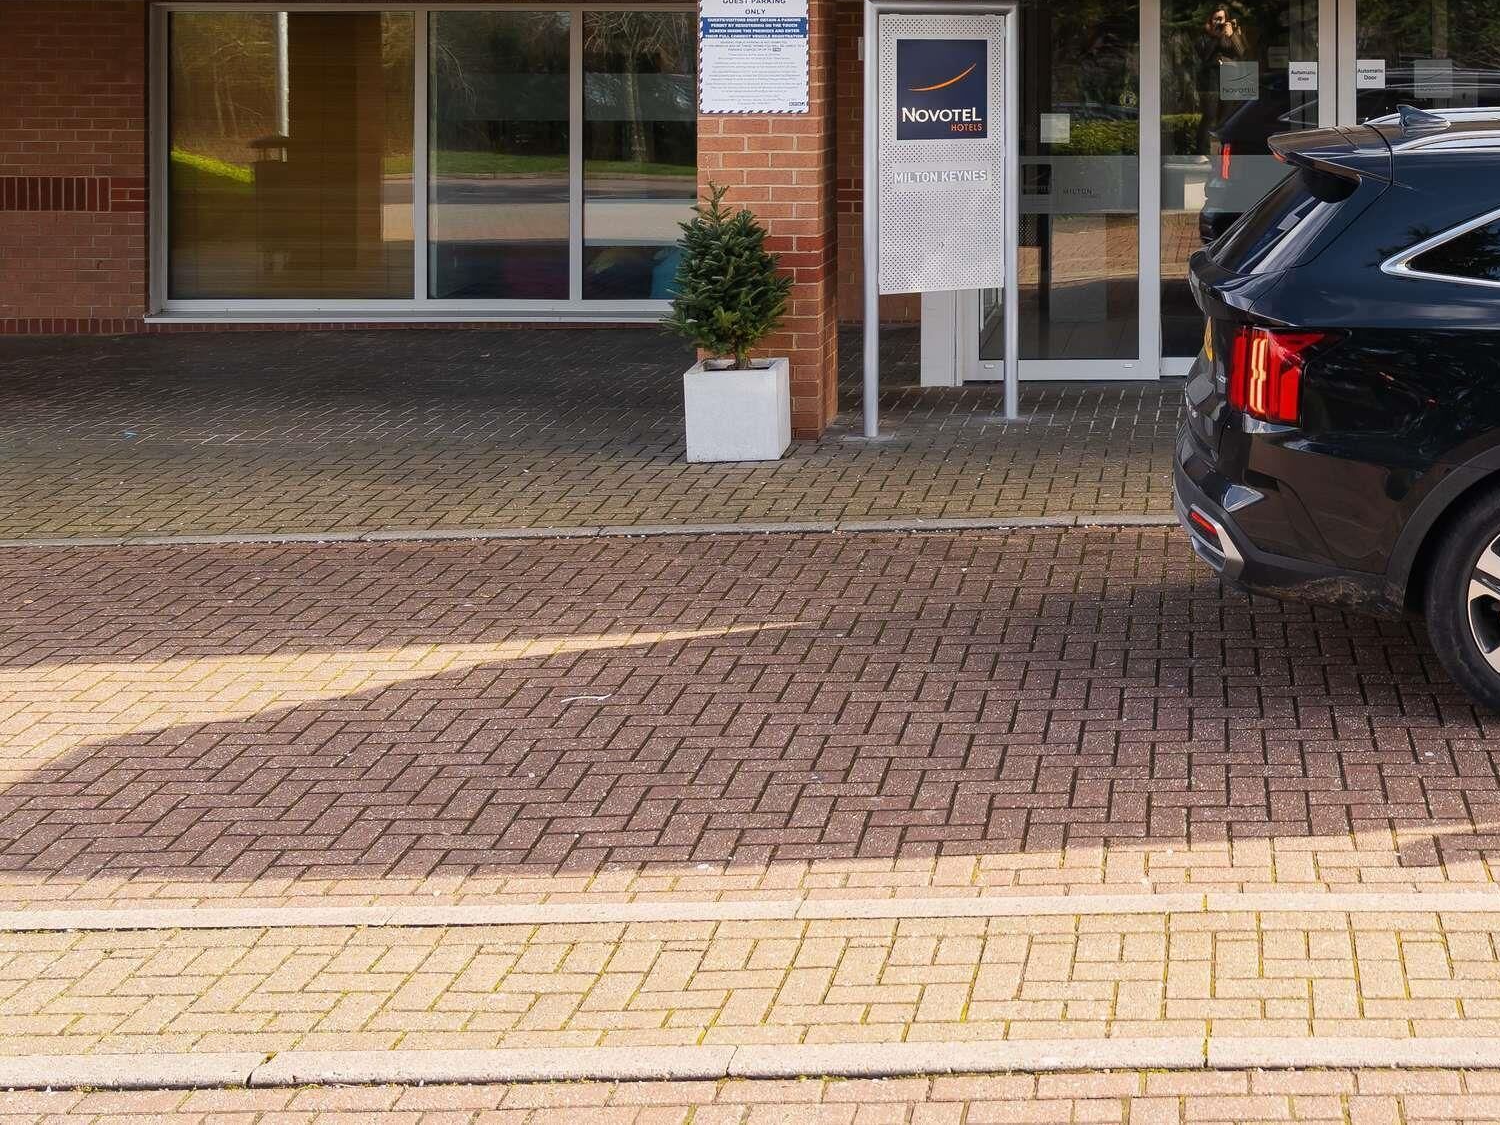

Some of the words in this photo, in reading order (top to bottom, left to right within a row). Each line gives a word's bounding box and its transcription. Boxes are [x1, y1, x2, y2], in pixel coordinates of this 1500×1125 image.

[902, 107, 982, 122] NOVOTEL
[951, 123, 983, 131] HOTELS
[894, 171, 938, 184] MILTON
[941, 170, 987, 182] KEYNES
